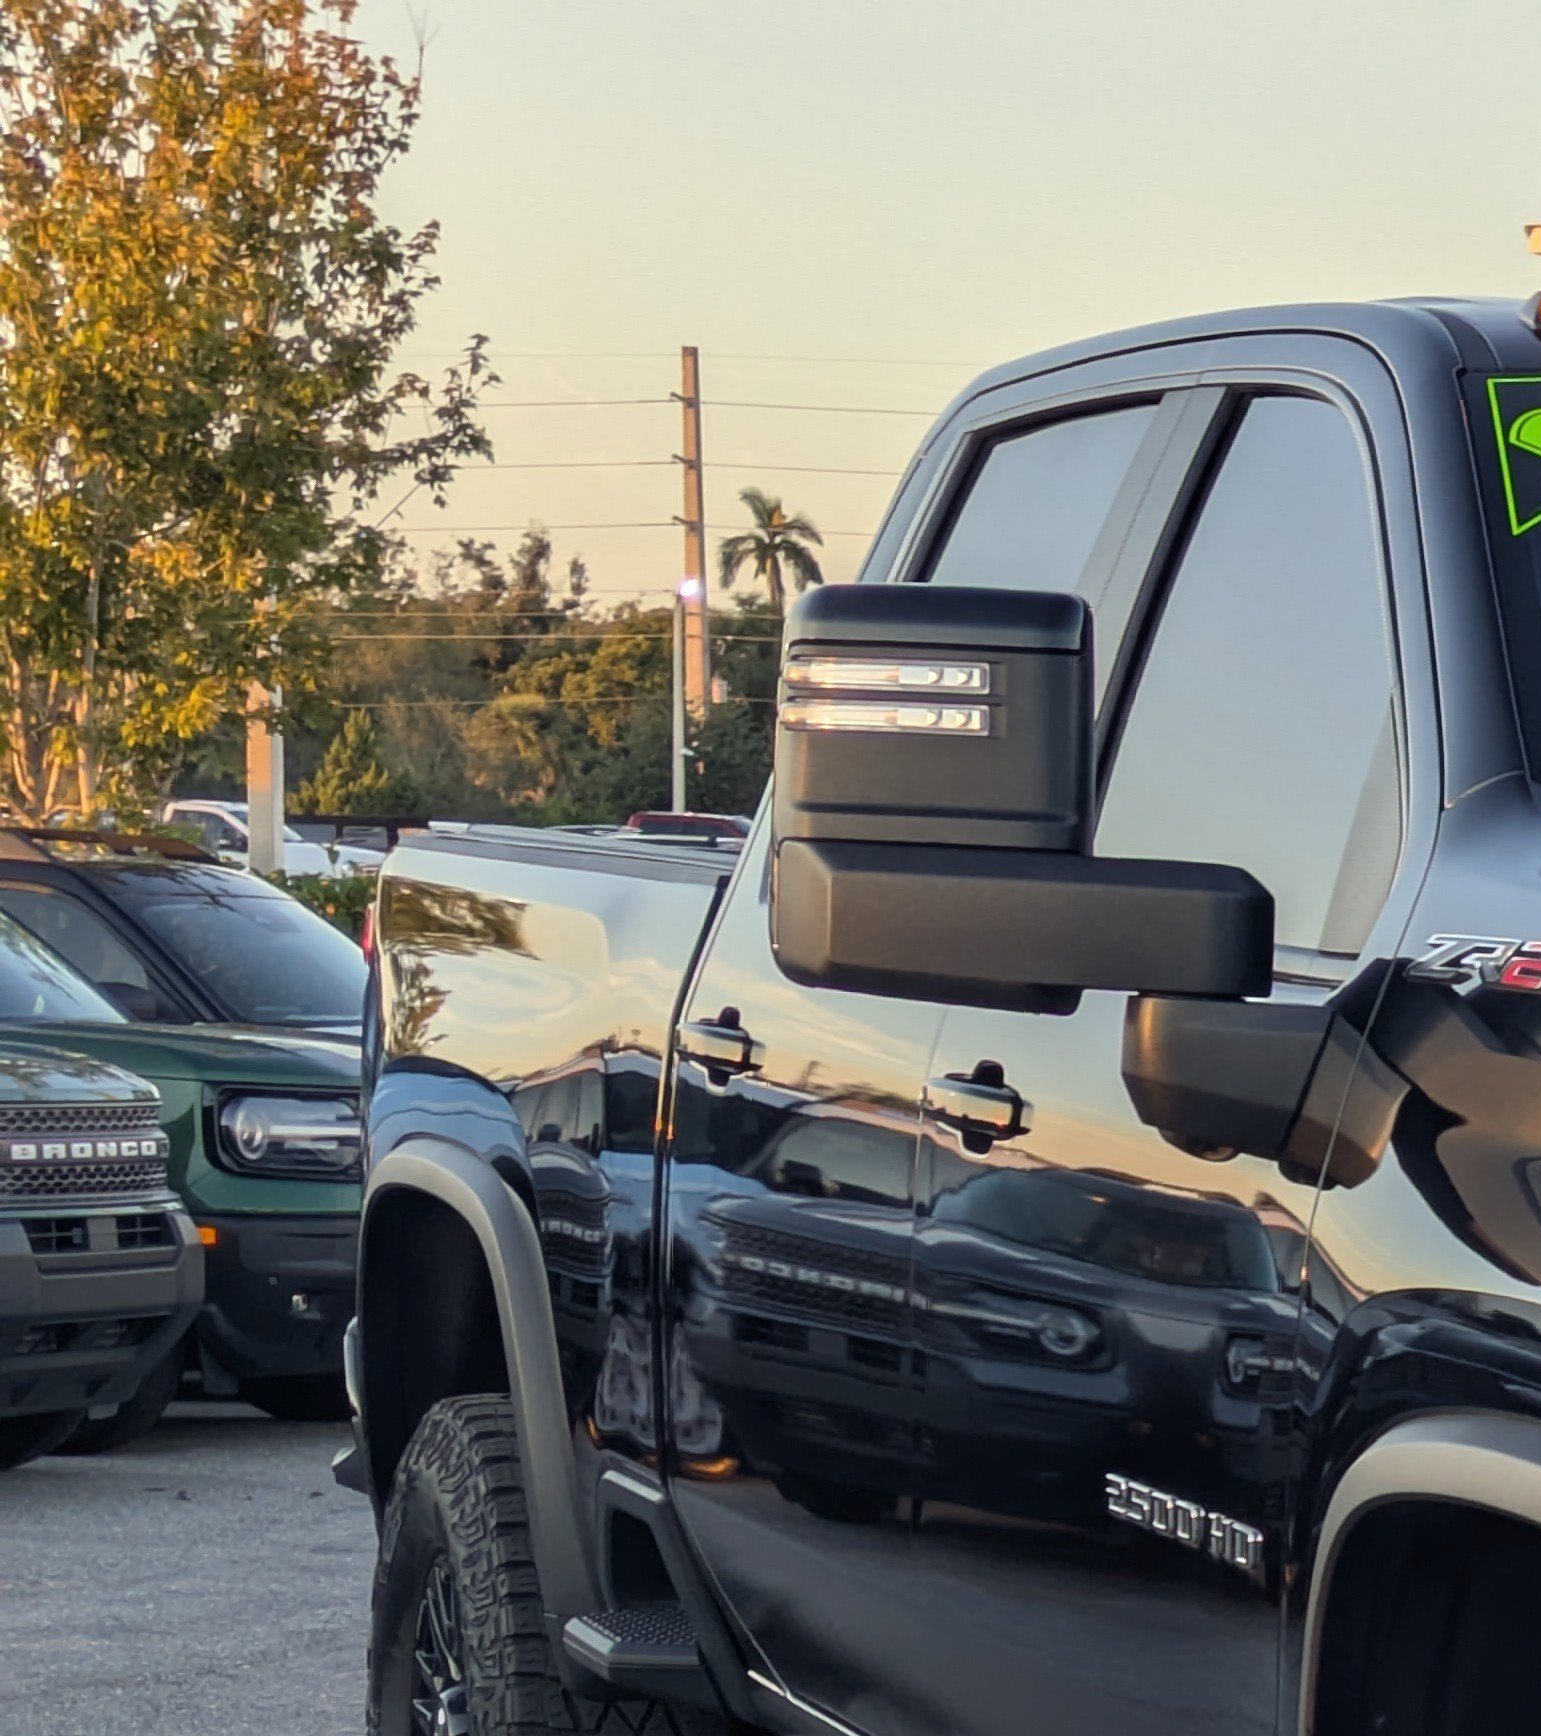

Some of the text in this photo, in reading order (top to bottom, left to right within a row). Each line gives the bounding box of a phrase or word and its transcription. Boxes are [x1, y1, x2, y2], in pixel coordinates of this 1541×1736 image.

[11, 1140, 158, 1160] BRONCO
[1104, 1472, 1264, 1572] 2500 HD
